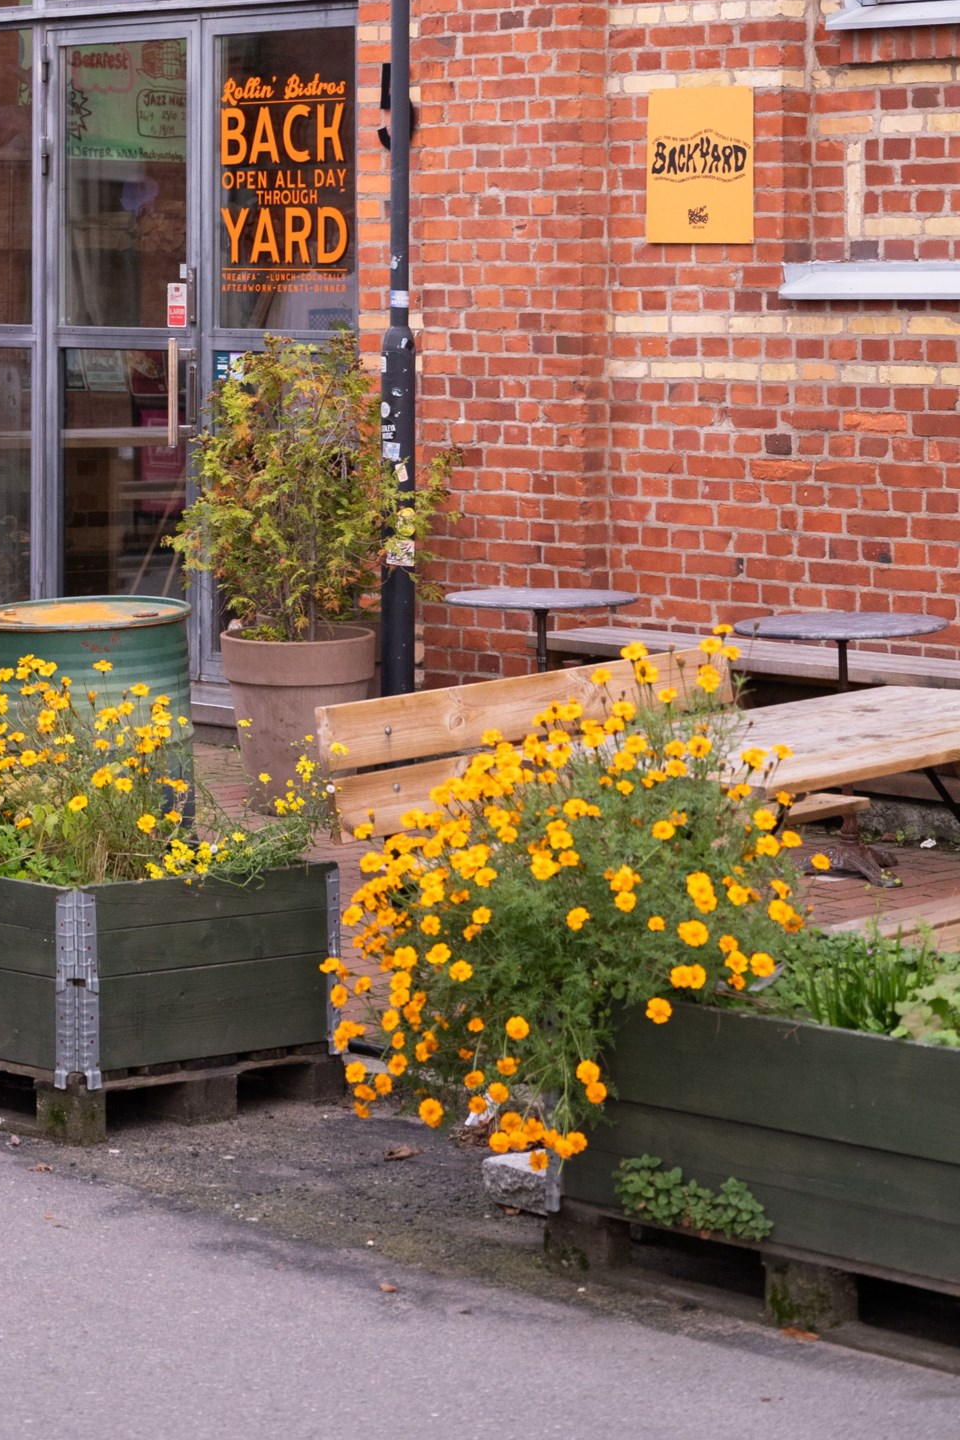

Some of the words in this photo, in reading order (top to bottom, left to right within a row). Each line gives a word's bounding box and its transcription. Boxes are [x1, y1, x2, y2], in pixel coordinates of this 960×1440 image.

[221, 76, 277, 106] Rollin'
[284, 73, 346, 100] Bistros
[220, 102, 345, 166] BACK
[651, 136, 747, 175] BACKYARD
[221, 170, 268, 191] OPEN
[275, 170, 307, 190] ALL
[313, 168, 348, 193] DAY
[256, 190, 319, 206] THROUGH
[220, 206, 349, 265] YARD
